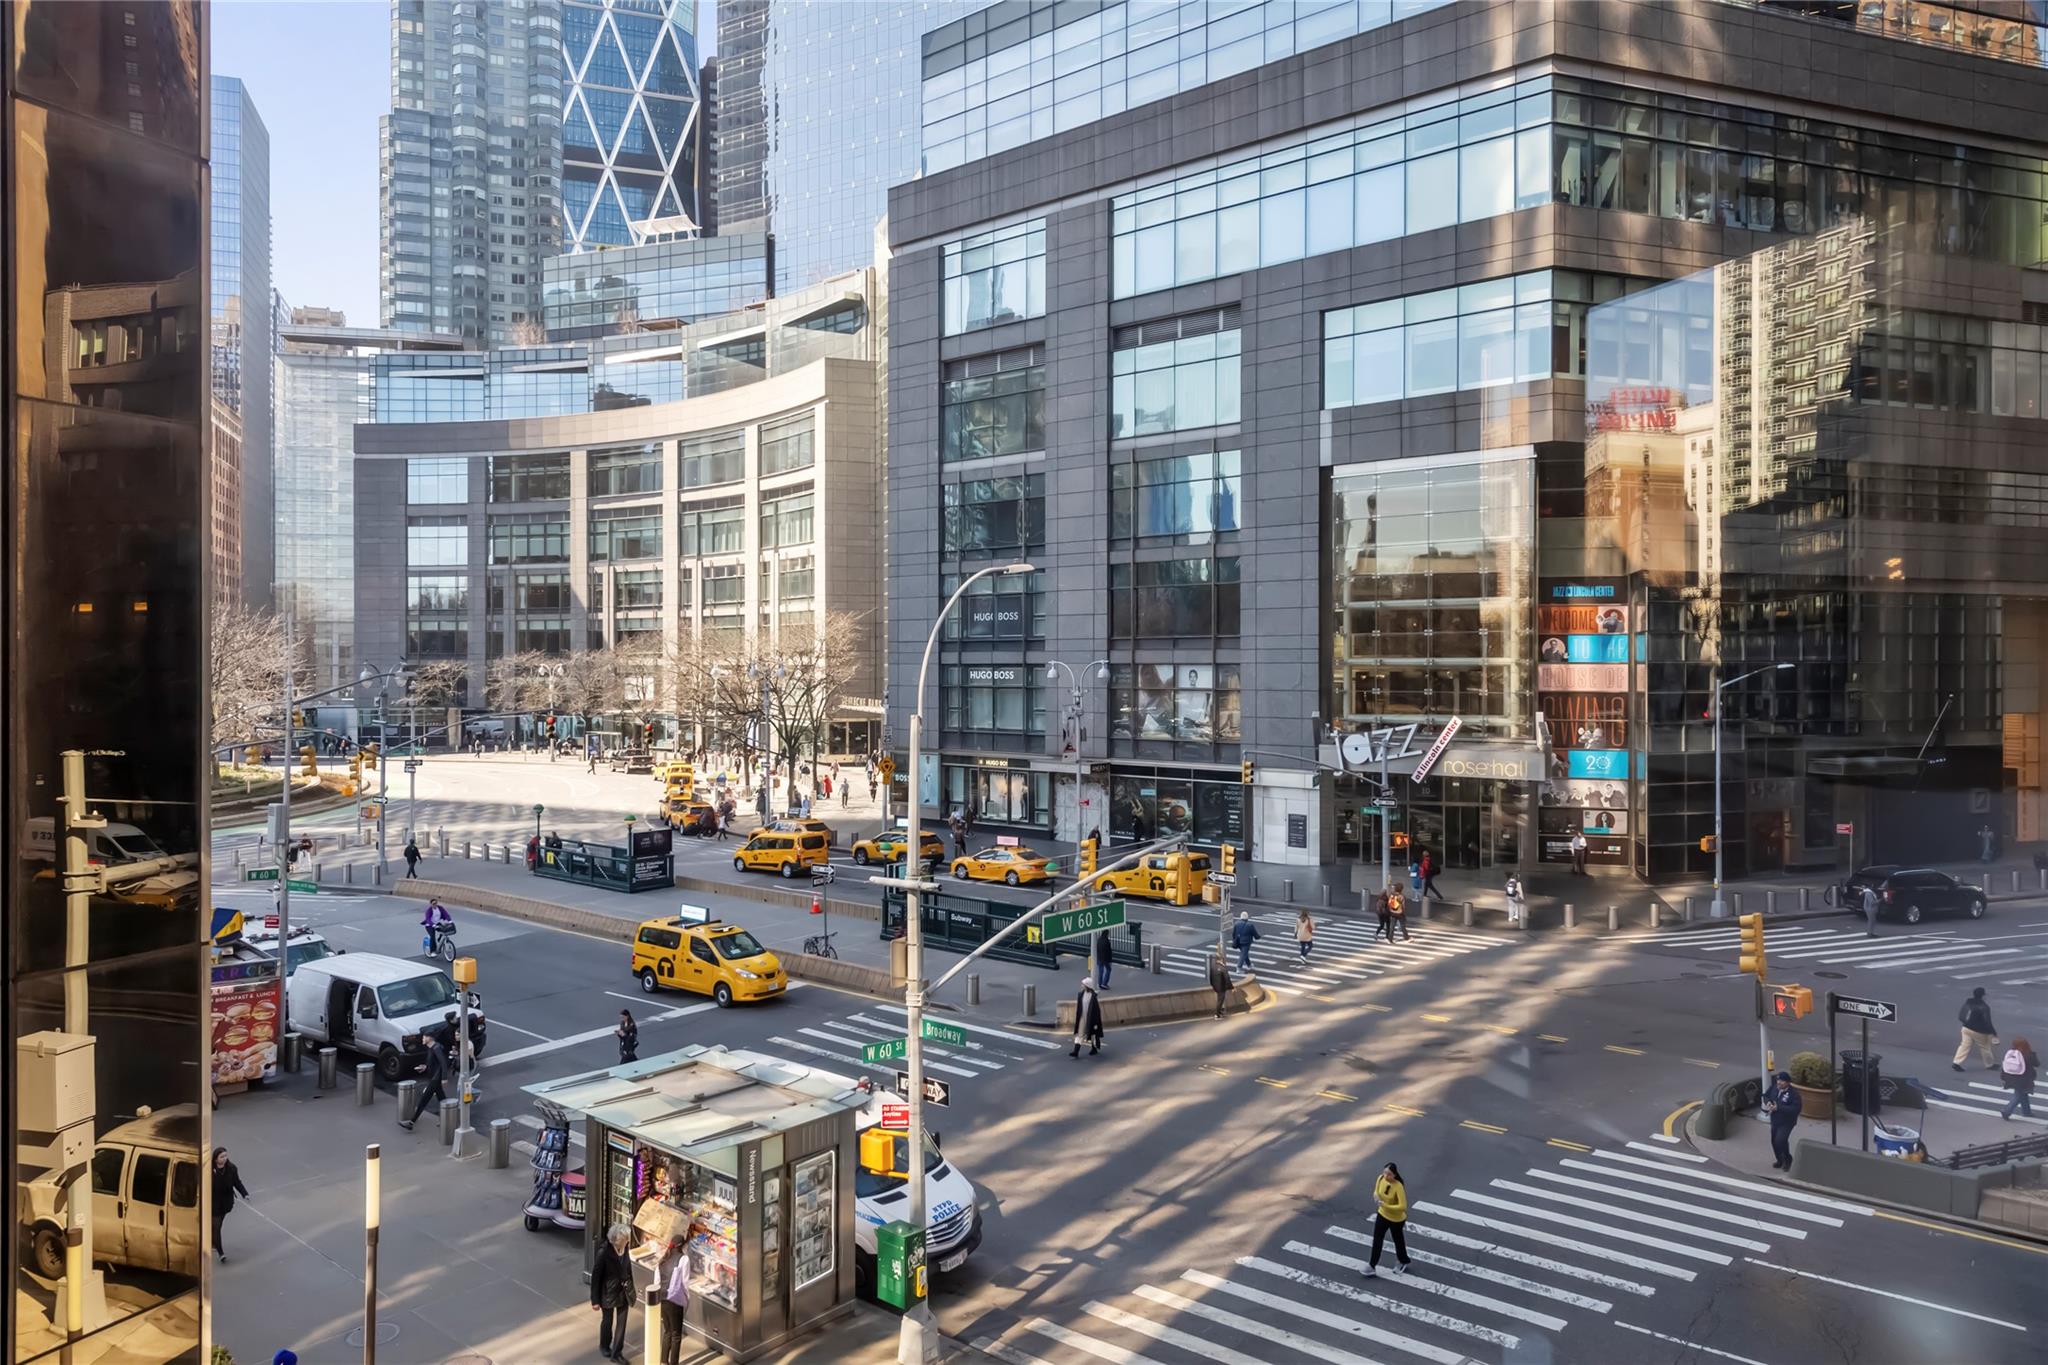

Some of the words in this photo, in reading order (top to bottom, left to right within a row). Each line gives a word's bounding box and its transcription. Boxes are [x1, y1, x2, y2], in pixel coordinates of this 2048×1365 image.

[998, 612, 1019, 621] BOSS
[1538, 610, 1595, 631] WELCOME
[970, 671, 992, 679] HUGO
[994, 671, 1014, 680] BOSS
[1542, 668, 1597, 689] HOUSE
[1605, 668, 1625, 689] OF
[1414, 769, 1424, 781] at
[1420, 745, 1441, 774] lincoln
[1440, 718, 1459, 745] center
[1443, 760, 1488, 776] rose
[1491, 760, 1528, 777] hall
[1585, 755, 1612, 770] 20
[951, 913, 973, 924] Subway
[1062, 916, 1072, 932] W
[1078, 912, 1092, 929] 60
[1098, 907, 1108, 925] St
[1843, 1001, 1860, 1010] ONE
[1868, 1006, 1886, 1015] WAY
[926, 1023, 961, 1044] Broadway
[866, 1046, 876, 1061] W
[879, 1043, 892, 1058] 60
[748, 1150, 757, 1204] Newsstand
[932, 1199, 953, 1214] NYPD
[932, 1203, 962, 1223] POLICE
